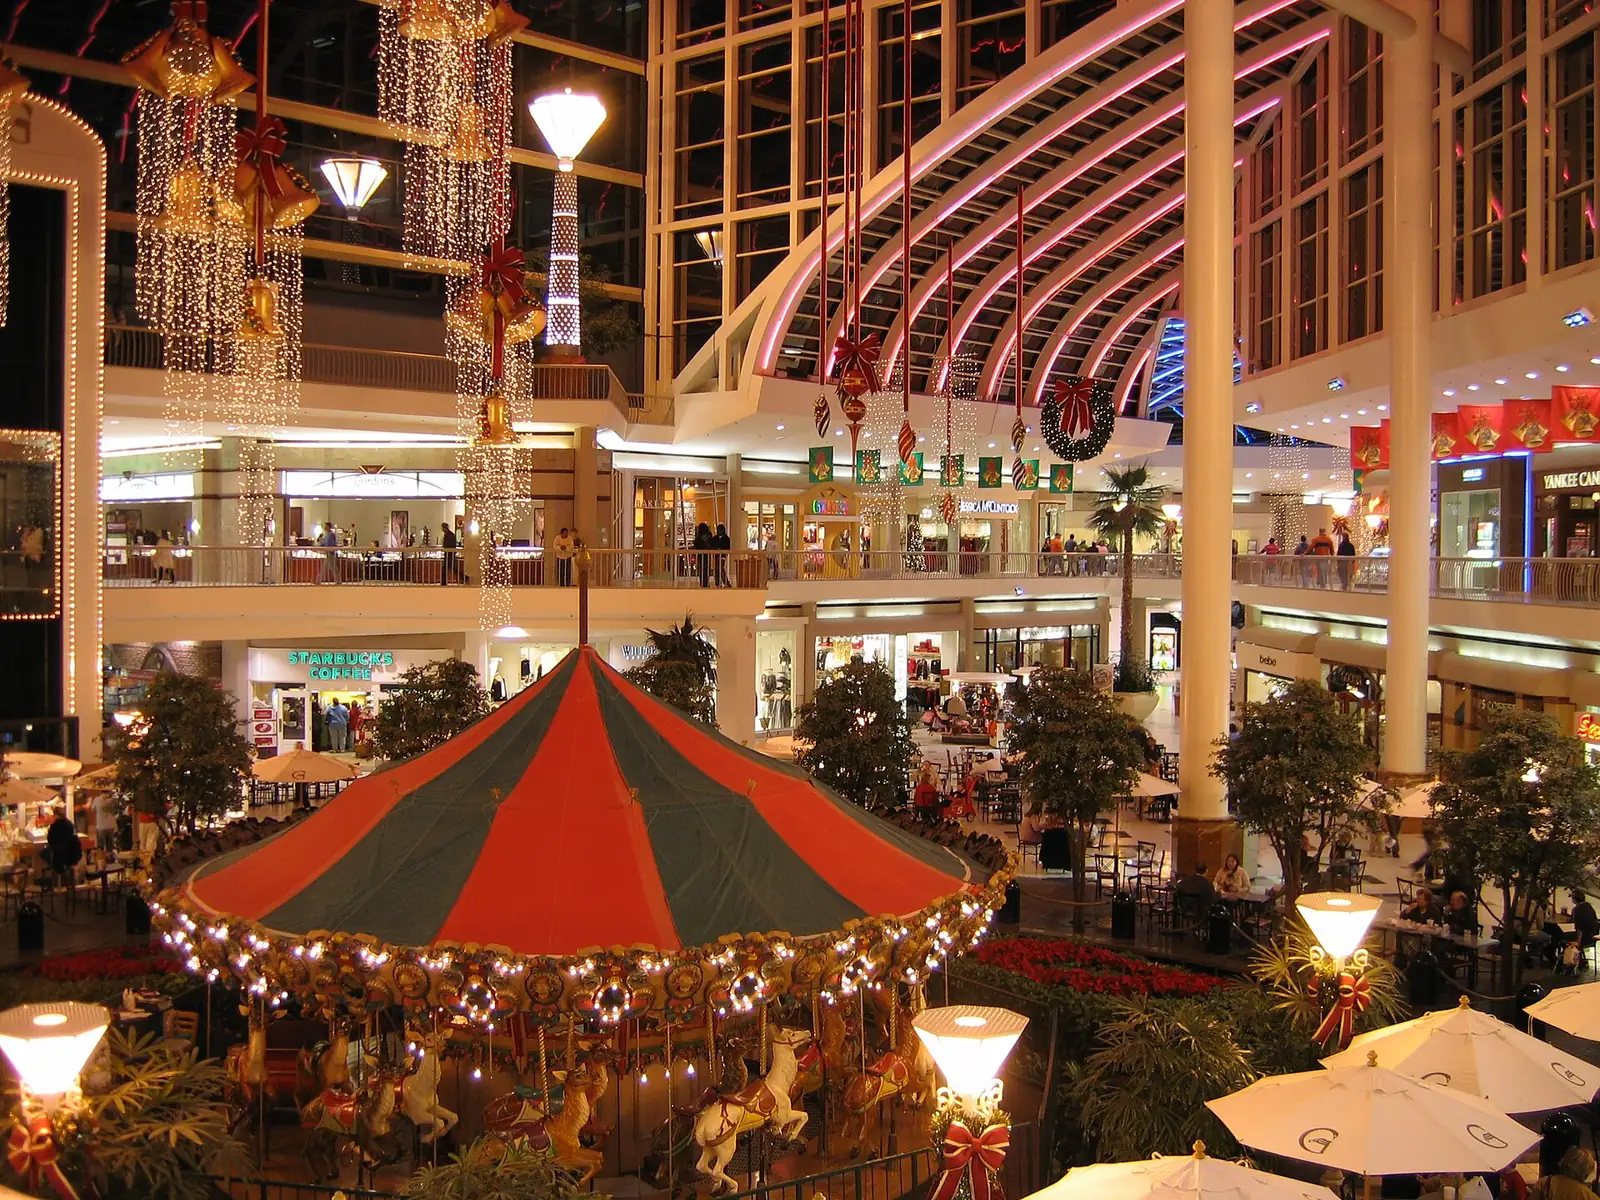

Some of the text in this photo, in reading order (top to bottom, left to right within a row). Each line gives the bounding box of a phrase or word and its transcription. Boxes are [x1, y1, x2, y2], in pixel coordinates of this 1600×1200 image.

[1544, 473, 1579, 489] YANKEE
[287, 651, 394, 665] STARBUCKS
[1259, 654, 1277, 667] bebe
[308, 666, 372, 680] COFFEE
